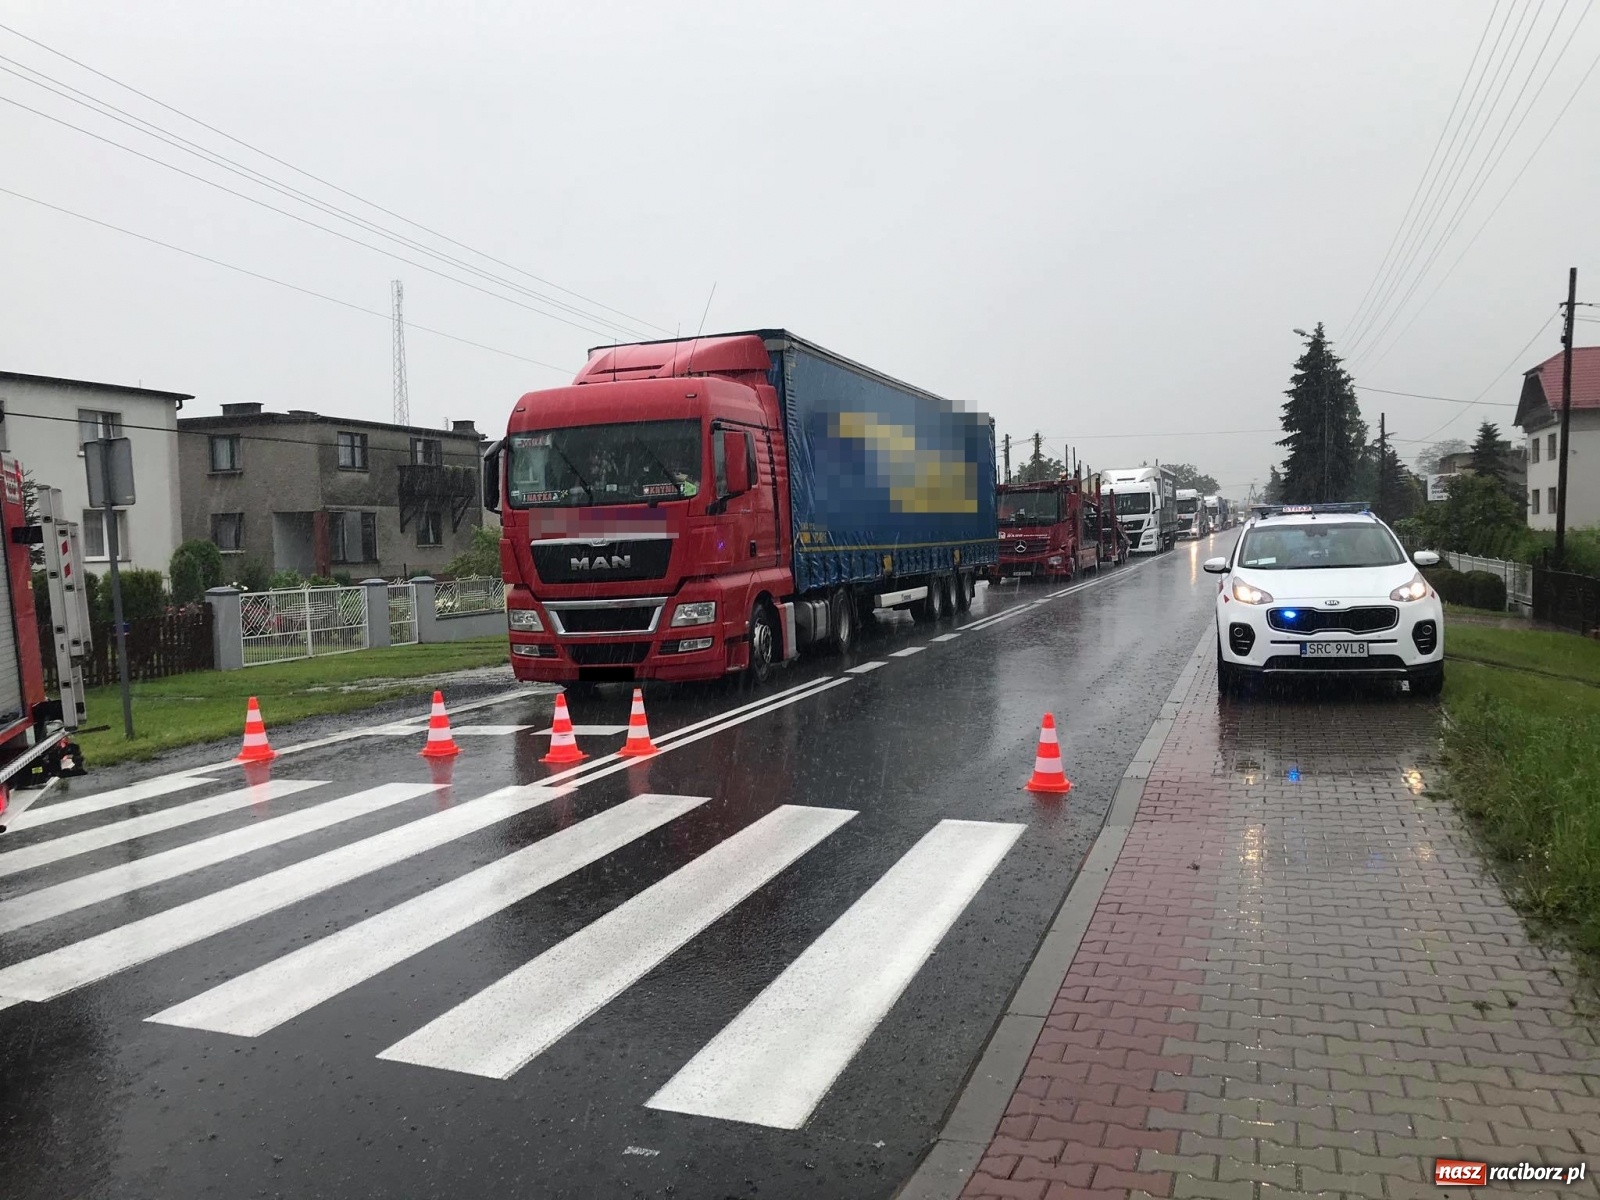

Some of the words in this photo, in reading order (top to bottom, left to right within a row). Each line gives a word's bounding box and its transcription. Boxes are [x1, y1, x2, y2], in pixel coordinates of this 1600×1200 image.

[570, 555, 631, 570] MAN
[1309, 643, 1331, 654] SRC
[1335, 643, 1365, 654] 9VL8
